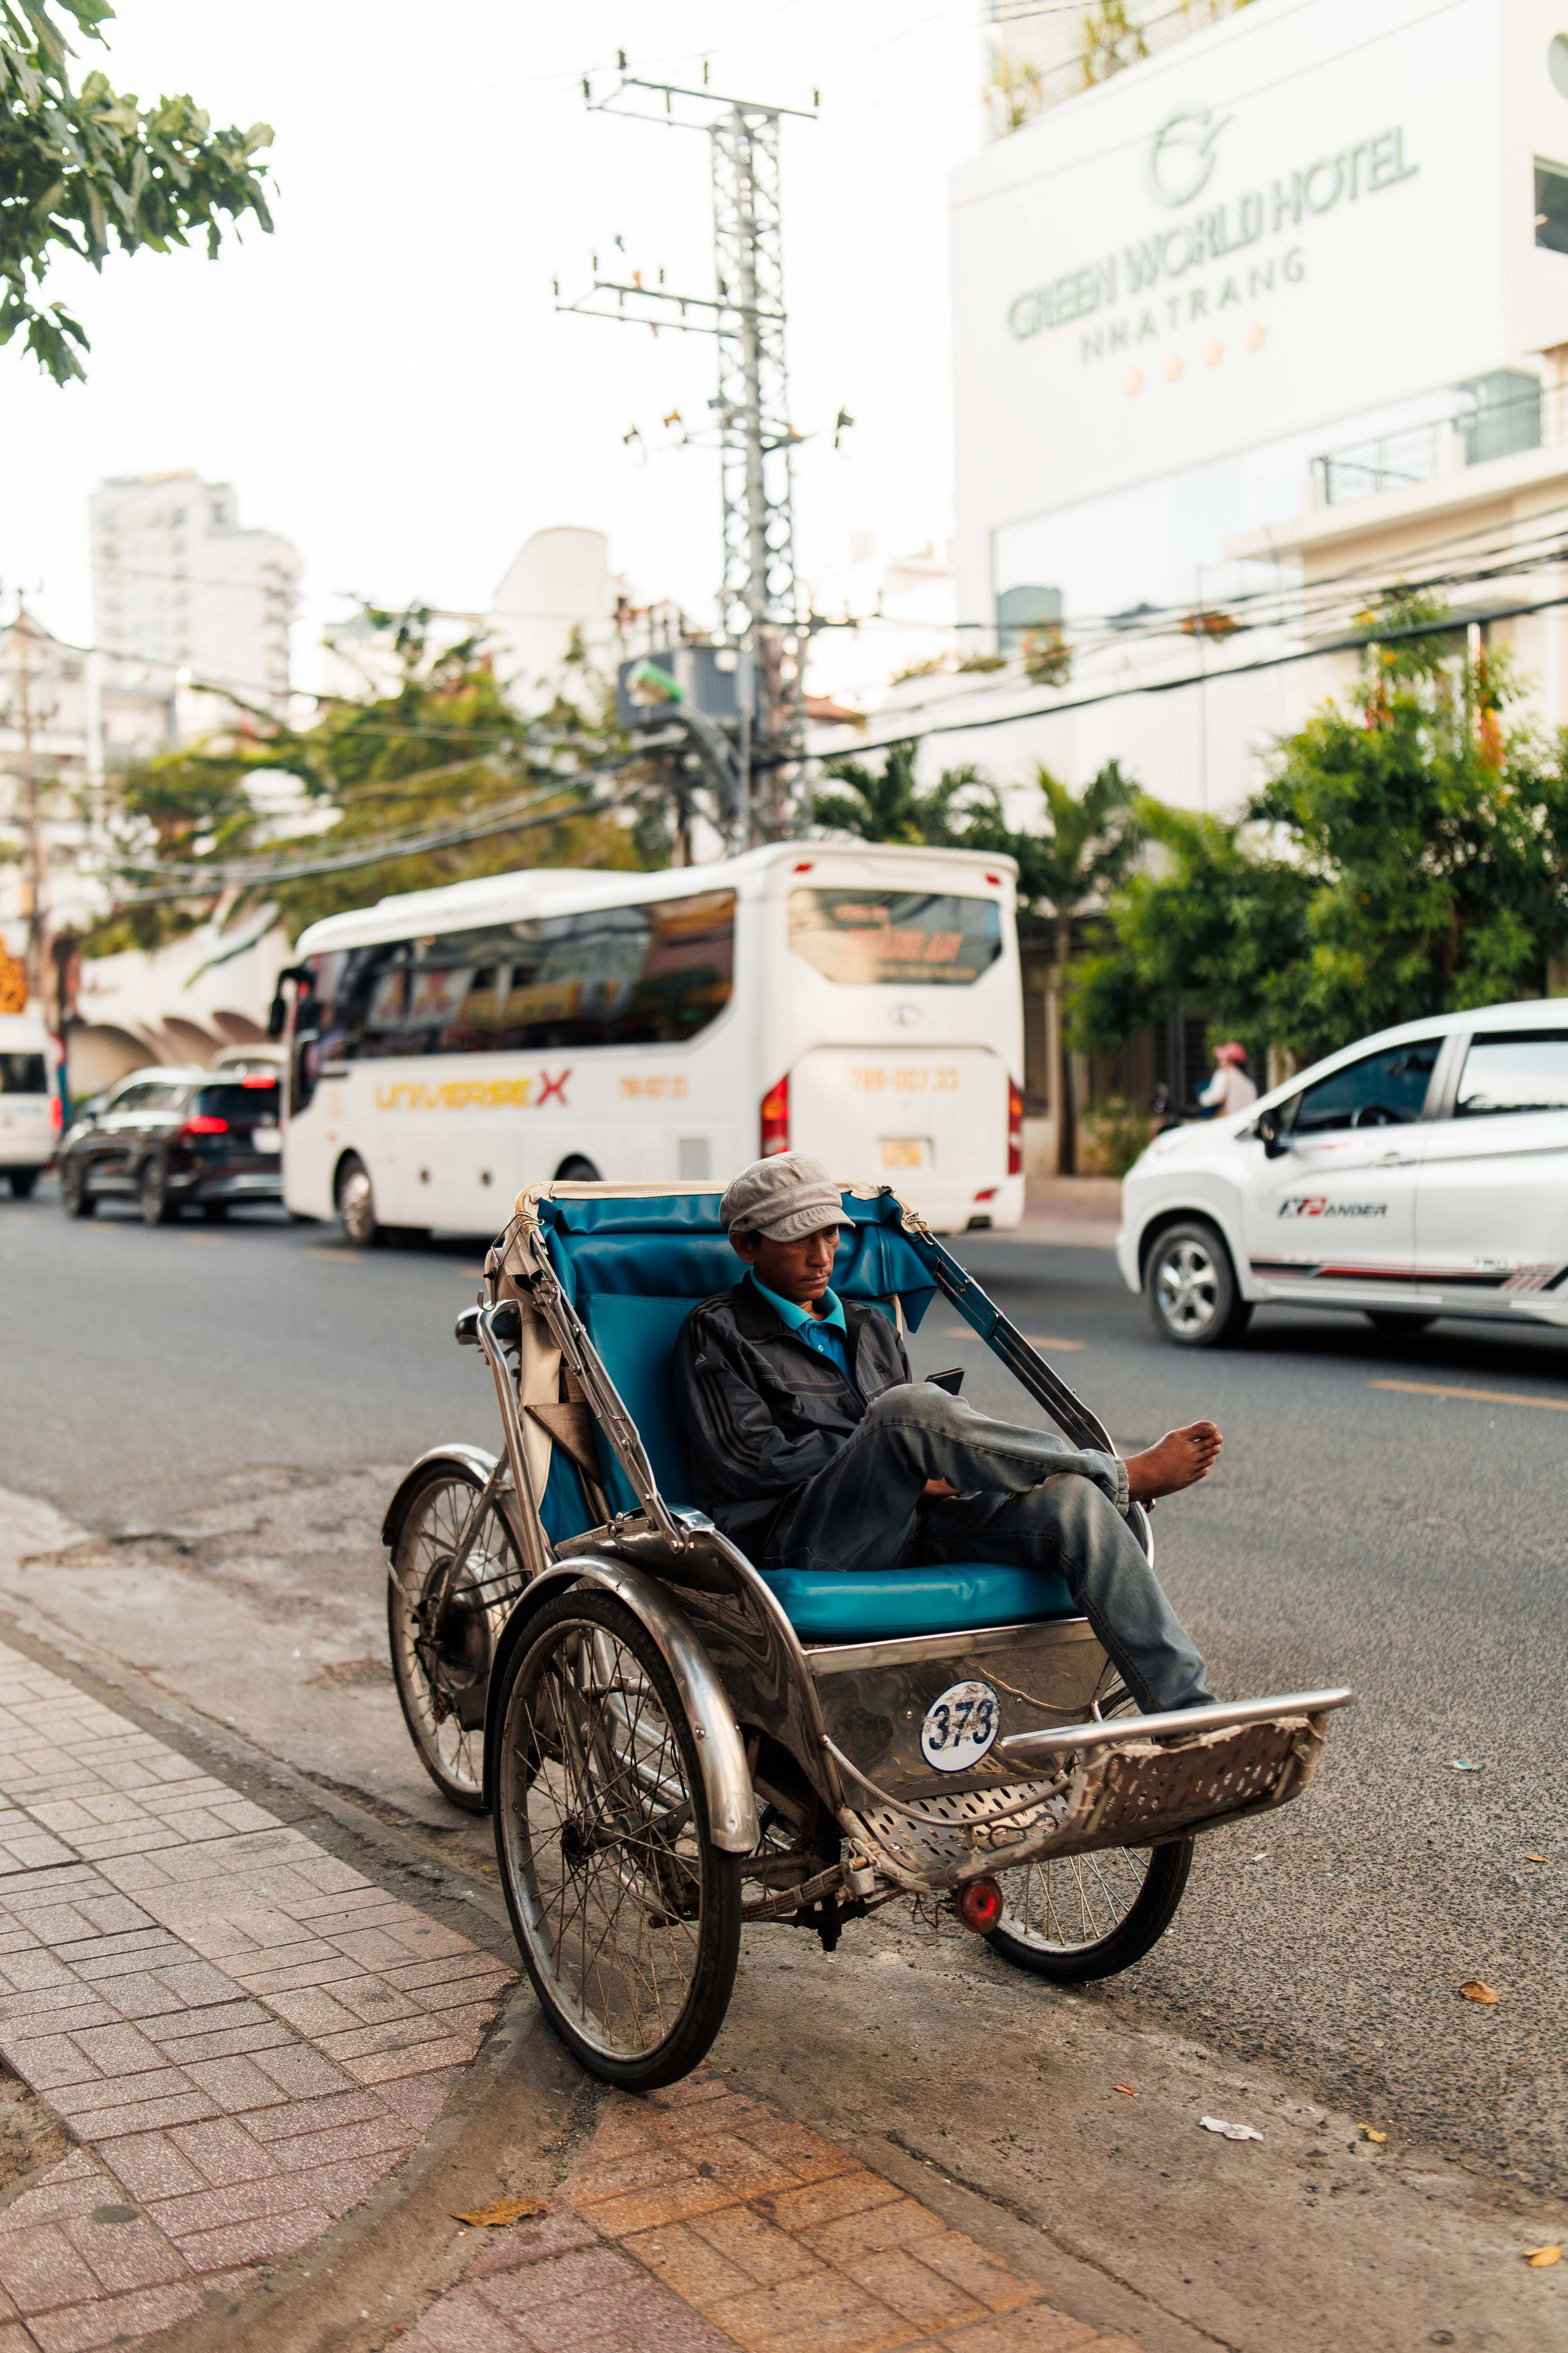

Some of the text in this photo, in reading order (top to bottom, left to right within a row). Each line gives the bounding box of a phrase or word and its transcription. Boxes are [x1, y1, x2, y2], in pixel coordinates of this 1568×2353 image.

[1008, 126, 1419, 341] GREEN WORLD HOTEL
[929, 1699, 993, 1750] 373
